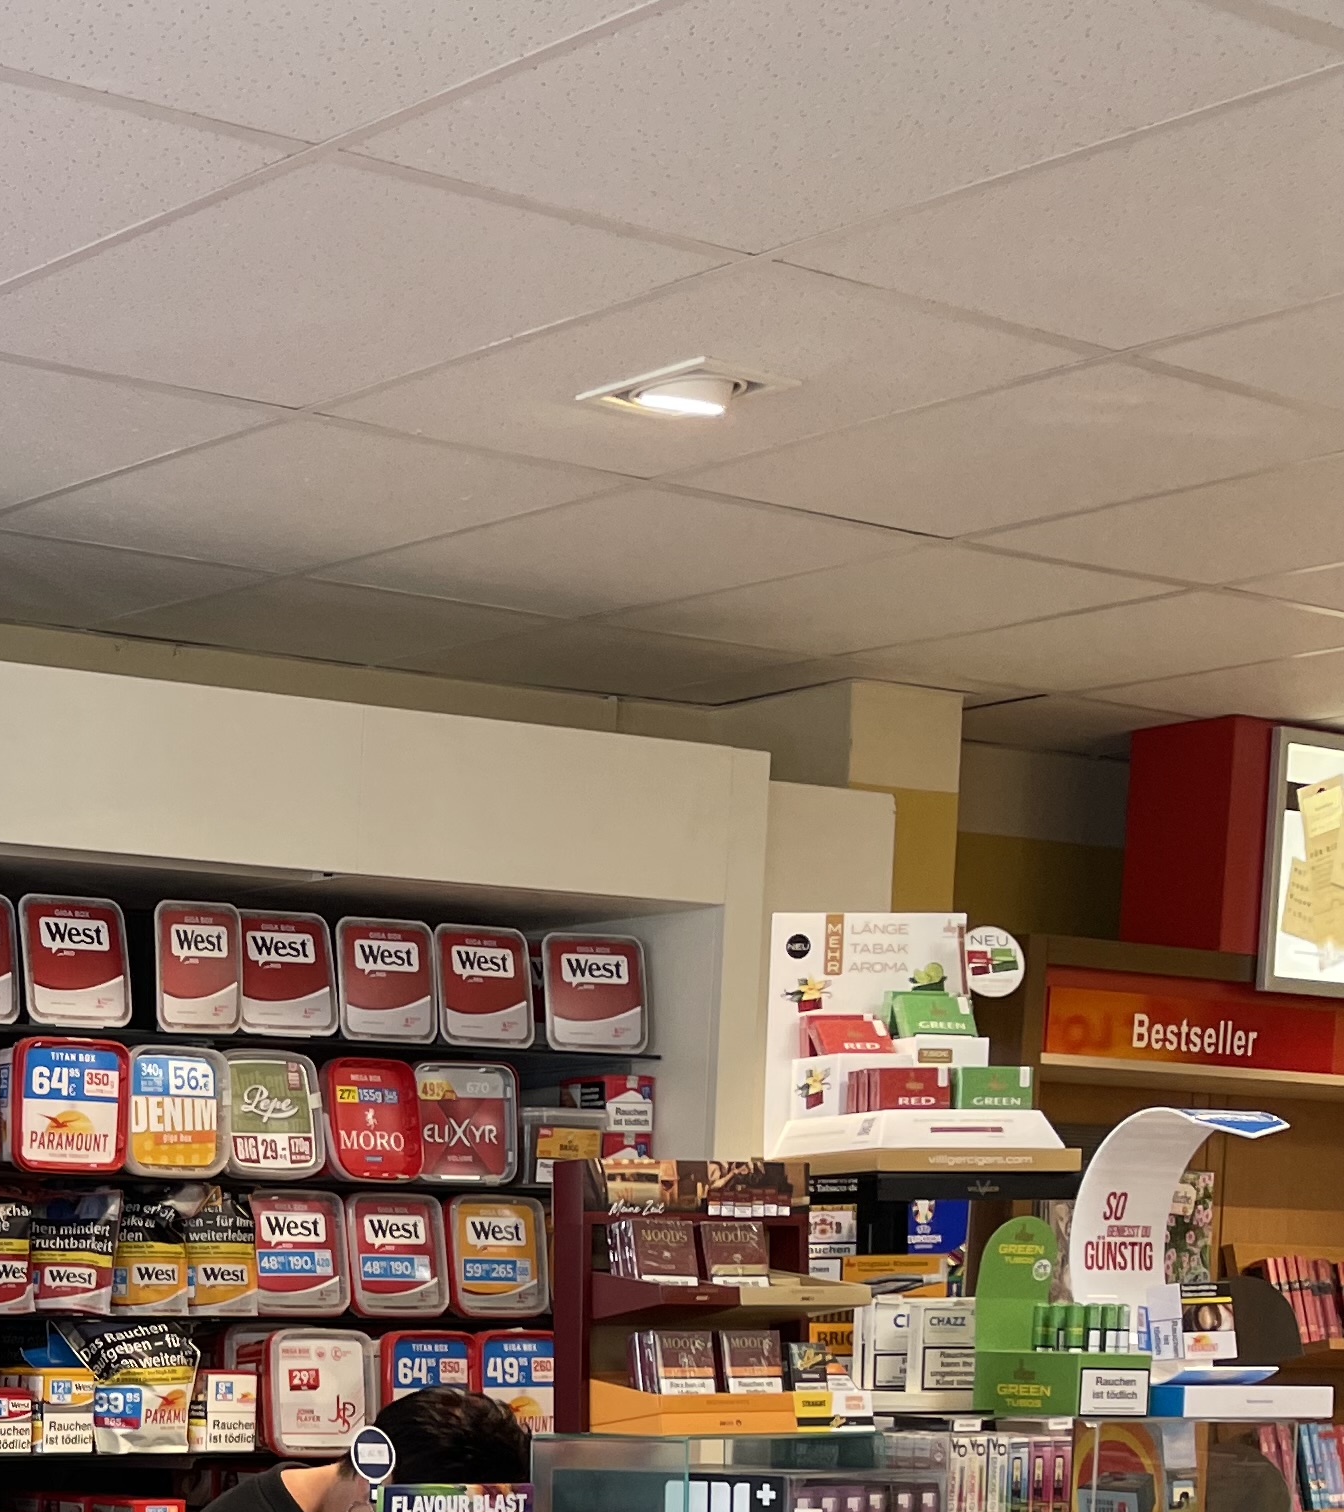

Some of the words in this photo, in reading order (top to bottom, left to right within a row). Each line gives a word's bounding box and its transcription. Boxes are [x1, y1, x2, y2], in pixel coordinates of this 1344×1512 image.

[850, 921, 909, 936] LÄNGE
[786, 941, 811, 952] NEU
[969, 934, 1009, 947] NEU
[850, 943, 909, 955] TABAK
[848, 961, 910, 974] AROMA
[1131, 1013, 1258, 1057] Bestseller
[843, 1040, 881, 1052] RED
[243, 1085, 299, 1122] Pepe
[898, 1096, 936, 1106] RED
[972, 1096, 1021, 1106] GREEN
[133, 1096, 217, 1135] DENIM
[423, 1117, 497, 1146] ELIXYR
[30, 1131, 108, 1153] PARAMOUNT
[340, 1128, 405, 1152] MORO
[237, 1137, 259, 1162] BIG
[928, 1154, 1033, 1166] villigercigars.com
[608, 1200, 642, 1216] Meine
[644, 1201, 665, 1214] Zeit
[1103, 1192, 1128, 1221] SO
[68, 1222, 110, 1237] mindert
[189, 1230, 255, 1242] weiterleben
[712, 1229, 759, 1244] MOODS
[1084, 1235, 1153, 1271] GÜNSTIG
[929, 1316, 966, 1327] CHAZZ
[997, 1384, 1051, 1397] GREEN
